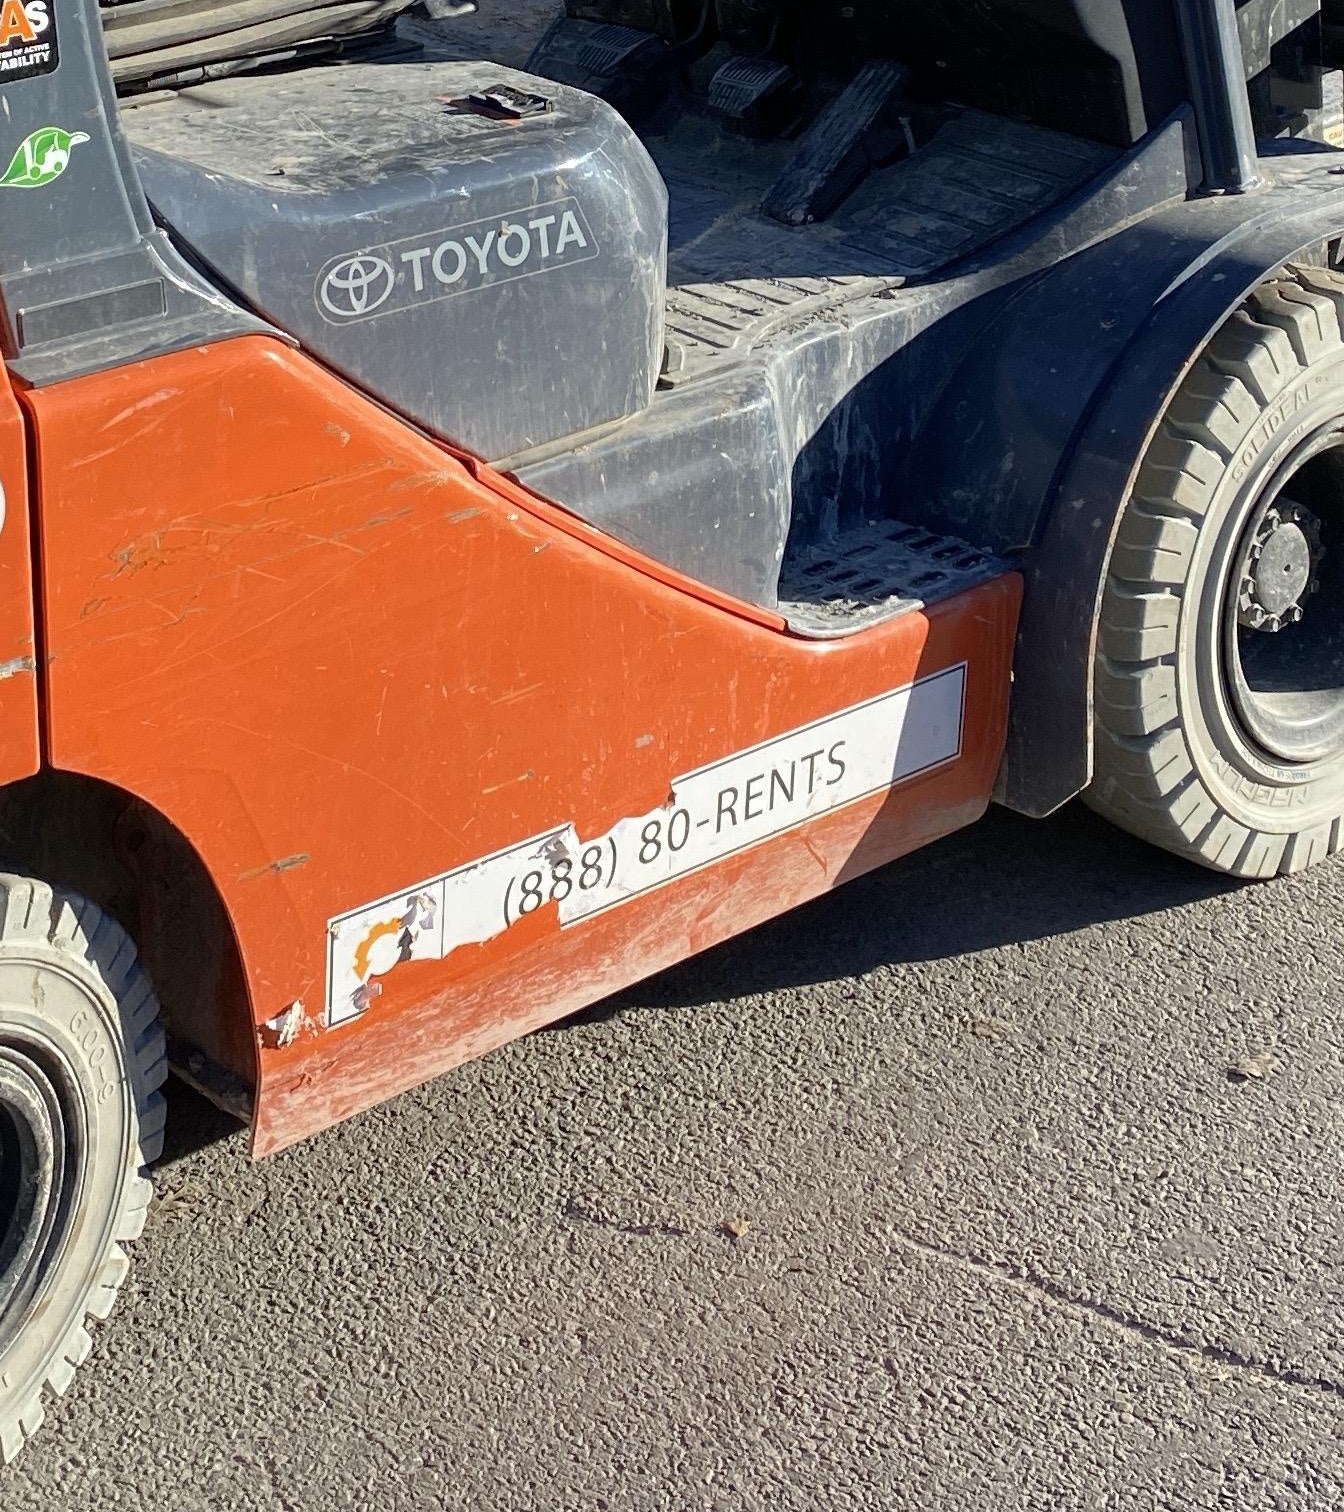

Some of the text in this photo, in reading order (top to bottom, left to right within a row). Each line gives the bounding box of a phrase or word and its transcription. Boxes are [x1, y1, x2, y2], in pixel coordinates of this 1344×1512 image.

[13, 47, 24, 57] OF
[24, 42, 50, 54] ACTIVE
[401, 210, 588, 292] TOYOTA
[503, 740, 847, 929] (888) 80-RENTS
